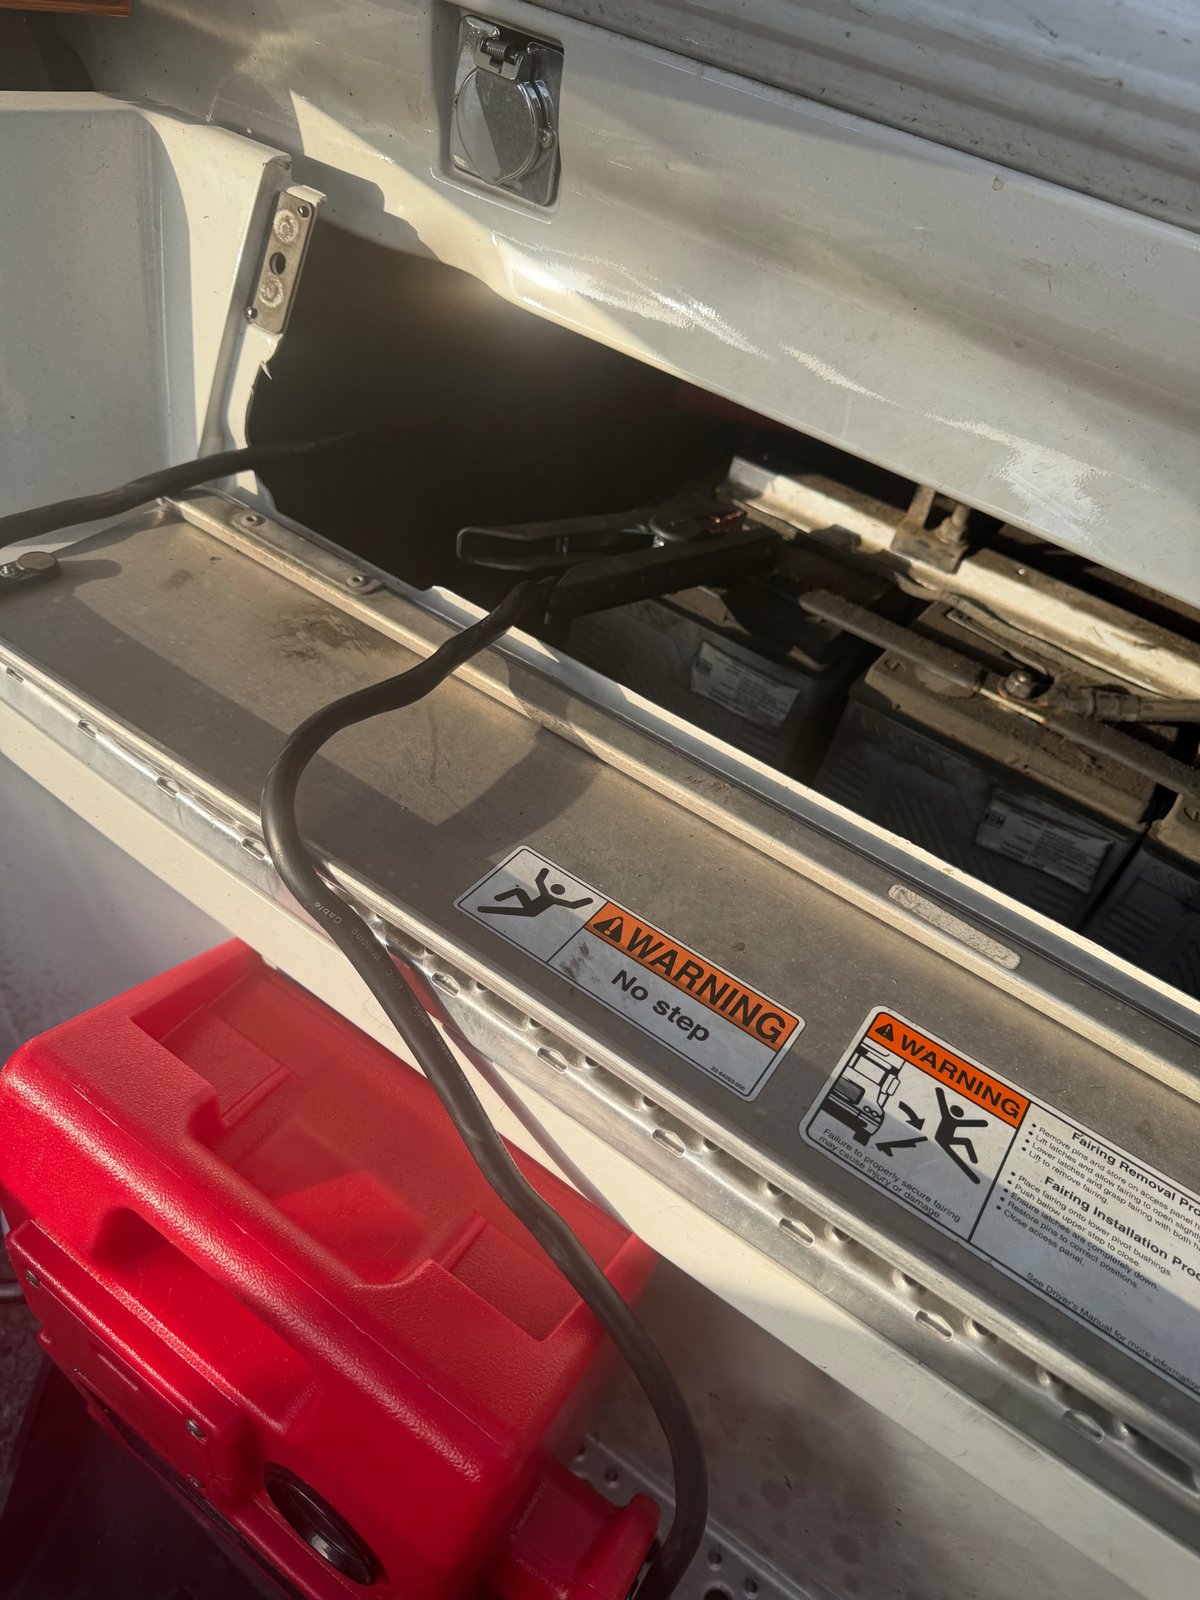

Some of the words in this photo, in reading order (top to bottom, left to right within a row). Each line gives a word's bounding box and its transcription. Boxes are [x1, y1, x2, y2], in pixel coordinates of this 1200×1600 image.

[315, 899, 343, 925] Cable
[611, 969, 648, 1001] No
[652, 1000, 709, 1041] step
[626, 927, 785, 1044] WARNING
[901, 1034, 1020, 1119] WARNING
[819, 1136, 838, 1152] may
[839, 1149, 865, 1169] cause
[866, 1167, 891, 1188] injury
[892, 1185, 903, 1193] or
[823, 1128, 852, 1151] Failure
[854, 1149, 863, 1157] to
[863, 1156, 900, 1183] properly
[901, 1180, 931, 1203] secure
[933, 1200, 961, 1223] fairing
[1029, 1150, 1041, 1162] Lift
[1042, 1159, 1050, 1167] to
[1052, 1166, 1081, 1186] remove
[1082, 1184, 1108, 1204] fairing.
[1032, 1142, 1056, 1160] Lower
[1057, 1158, 1085, 1179] latches
[1086, 1178, 1103, 1189] and
[1103, 1188, 1126, 1204] grasp
[1128, 1202, 1153, 1222] fairing
[1155, 1219, 1171, 1232] with
[1173, 1229, 1191, 1245] both
[1036, 1135, 1048, 1146] Lift
[1049, 1143, 1076, 1164] latches
[1078, 1162, 1094, 1174] and
[1094, 1173, 1115, 1187] allow
[1117, 1185, 1141, 1205] fairing
[1143, 1201, 1151, 1209] to
[1153, 1208, 1174, 1225] open
[1039, 1127, 1070, 1150] Remove
[1071, 1148, 1088, 1161] pins
[1089, 1160, 1105, 1171] and
[1106, 1169, 1126, 1184] store
[1140, 1190, 1167, 1209] access
[1170, 1209, 1193, 1224] panel
[1072, 1132, 1116, 1166] Fairing
[1119, 1161, 1176, 1200] Removal
[1004, 1209, 1027, 1228] Close
[1029, 1226, 1057, 1248] access
[1007, 1201, 1039, 1225] Restore
[1040, 1223, 1058, 1237] pins
[1059, 1234, 1068, 1243] to
[1069, 1242, 1098, 1263] correct
[1010, 1192, 1040, 1214] Ensure
[1041, 1211, 1070, 1234] latches
[1072, 1232, 1086, 1243] are
[1087, 1242, 1132, 1272] completely
[1014, 1183, 1035, 1200] Push
[1036, 1197, 1061, 1216] below
[1062, 1215, 1086, 1232] upper
[1087, 1231, 1105, 1245] step
[1107, 1242, 1115, 1251] to
[1018, 1175, 1040, 1193] Place
[1042, 1190, 1067, 1211] fairing
[1068, 1208, 1086, 1222] onto
[1088, 1219, 1110, 1237] lower
[1111, 1235, 1132, 1251] pivot
[1044, 1176, 1090, 1212] Fairing
[1093, 1206, 1167, 1259] Installation
[1027, 1272, 1044, 1287] See
[1046, 1285, 1079, 1310] Driver's
[1079, 1308, 1112, 1332] Manual
[1114, 1330, 1127, 1342] for
[1128, 1341, 1151, 1358] more
